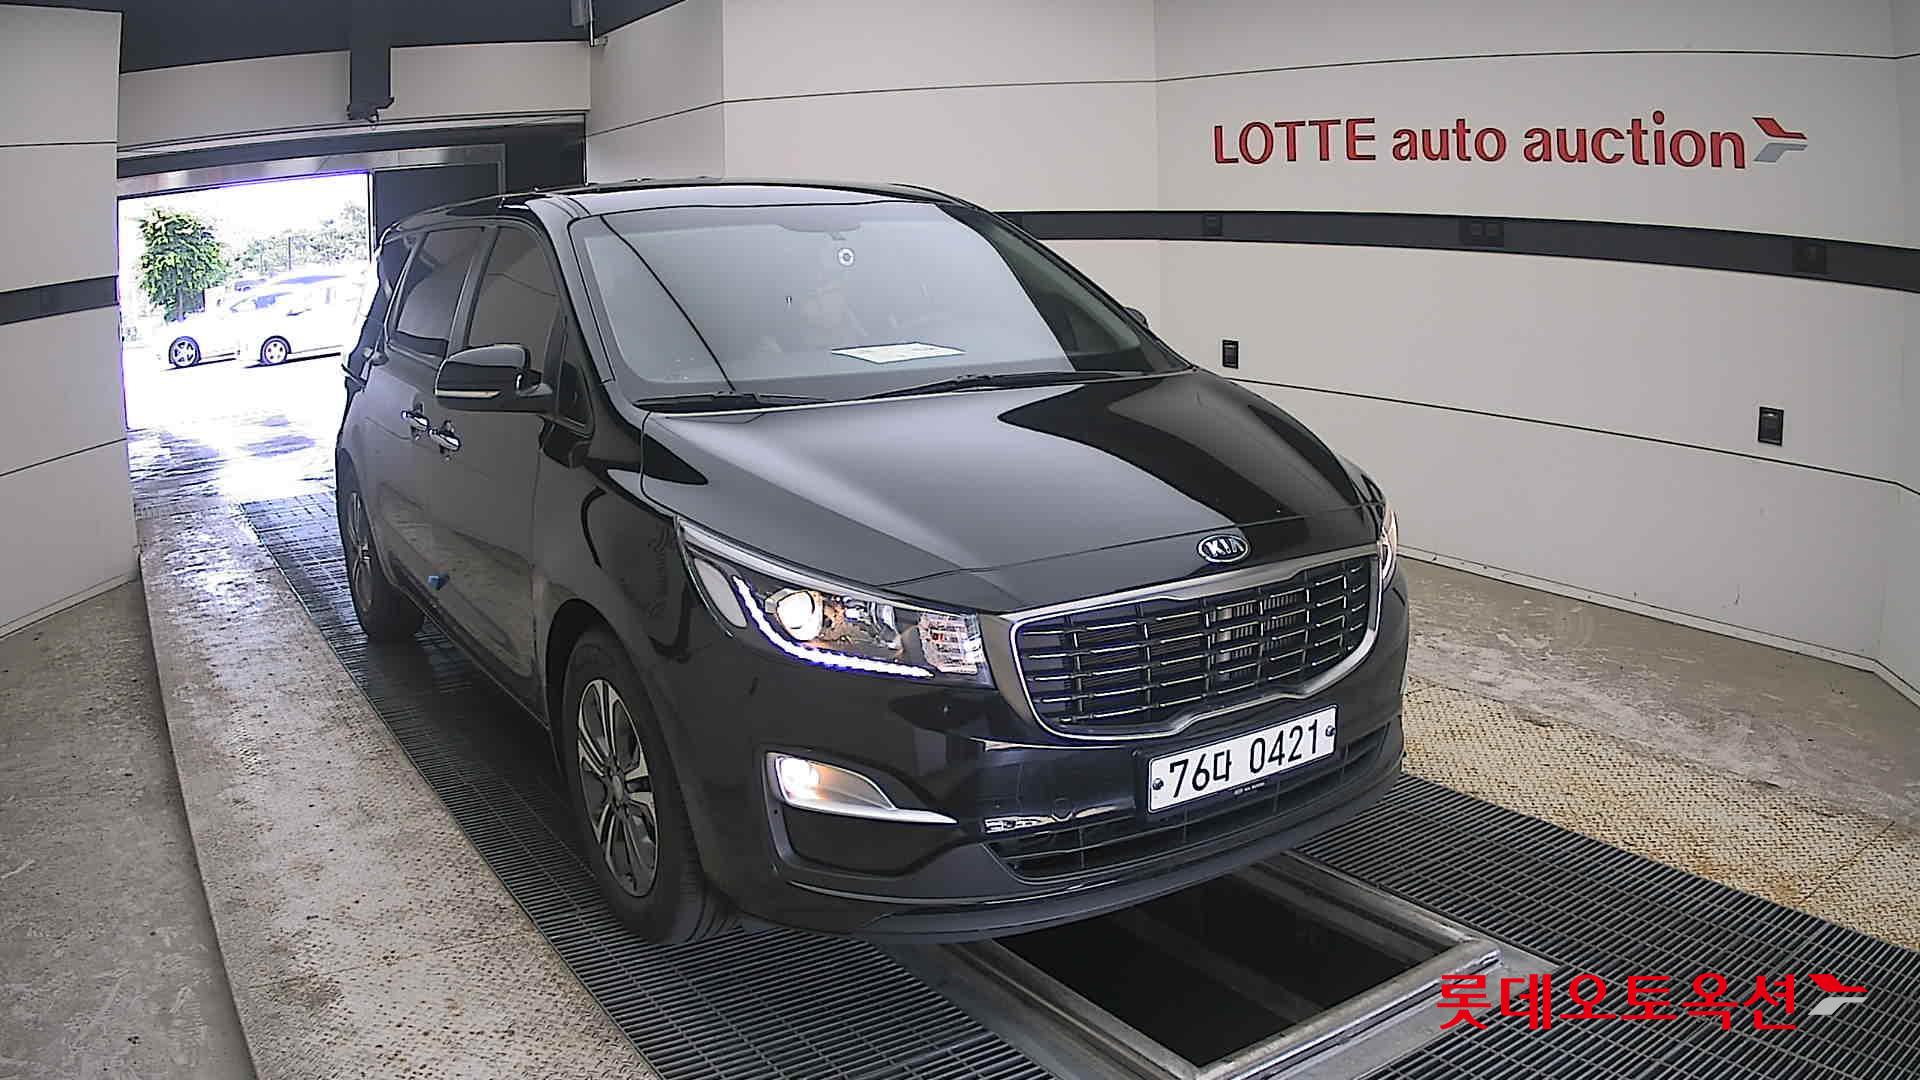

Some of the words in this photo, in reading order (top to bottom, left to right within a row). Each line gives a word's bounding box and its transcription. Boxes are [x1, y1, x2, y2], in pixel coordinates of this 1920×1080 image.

[1214, 117, 1376, 164] LOTTE
[1392, 118, 1506, 161] auto
[1523, 110, 1746, 169] auction
[1205, 537, 1244, 558] KIA
[1169, 749, 1232, 798] 76다
[1249, 718, 1318, 774] 0421
